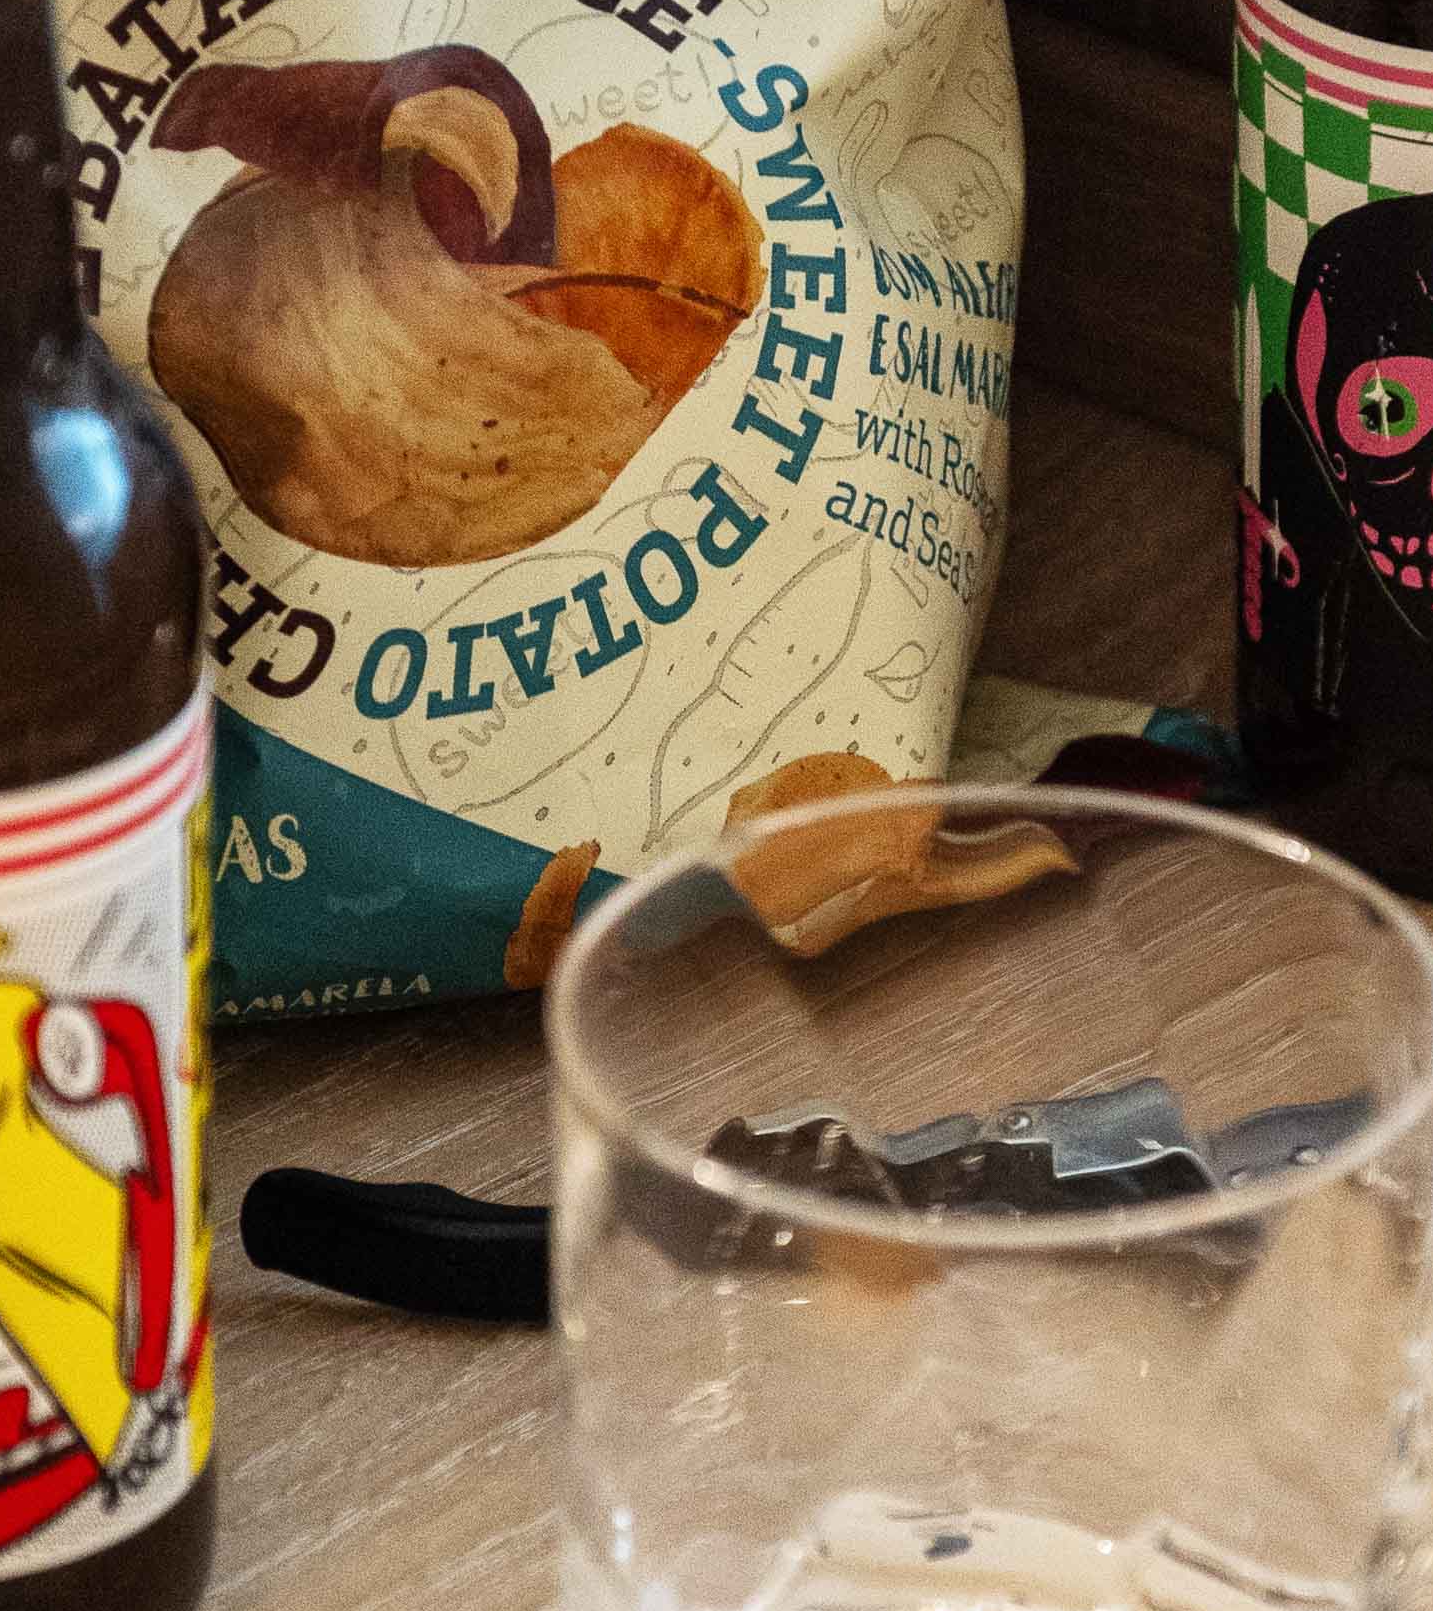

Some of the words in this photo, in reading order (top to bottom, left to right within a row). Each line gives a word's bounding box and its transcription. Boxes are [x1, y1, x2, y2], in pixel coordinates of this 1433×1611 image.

[716, 63, 848, 484] SWEET
[825, 479, 915, 553] and
[854, 407, 933, 480] with
[352, 463, 768, 720] POTATO
